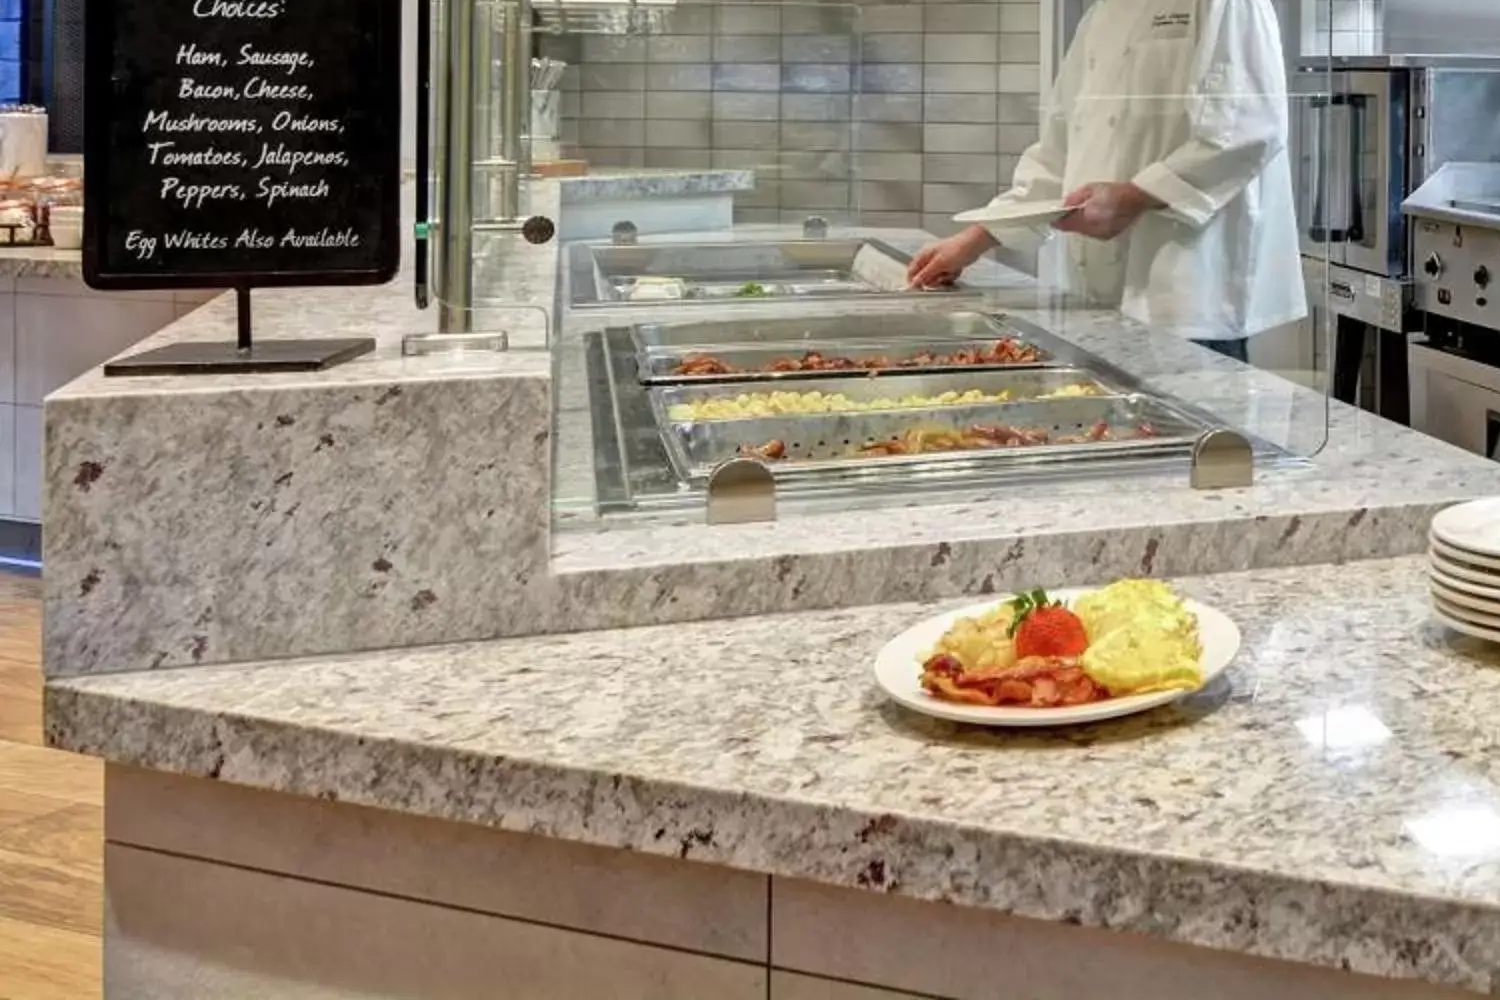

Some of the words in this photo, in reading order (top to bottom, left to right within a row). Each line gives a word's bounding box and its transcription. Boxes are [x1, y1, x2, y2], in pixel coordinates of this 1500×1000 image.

[176, 44, 227, 67] Ham,
[237, 44, 314, 75] Sausage,
[143, 110, 263, 133] Mushrooms,
[272, 111, 344, 133] Onions,
[148, 142, 247, 167] Tomatoes,
[252, 143, 349, 175] Jalapenos,
[161, 178, 245, 208] Peppers,
[256, 176, 329, 208] Spinach
[126, 230, 156, 259] Egg
[165, 230, 228, 248] Whites
[235, 229, 274, 248] Also
[280, 227, 360, 247] Available
